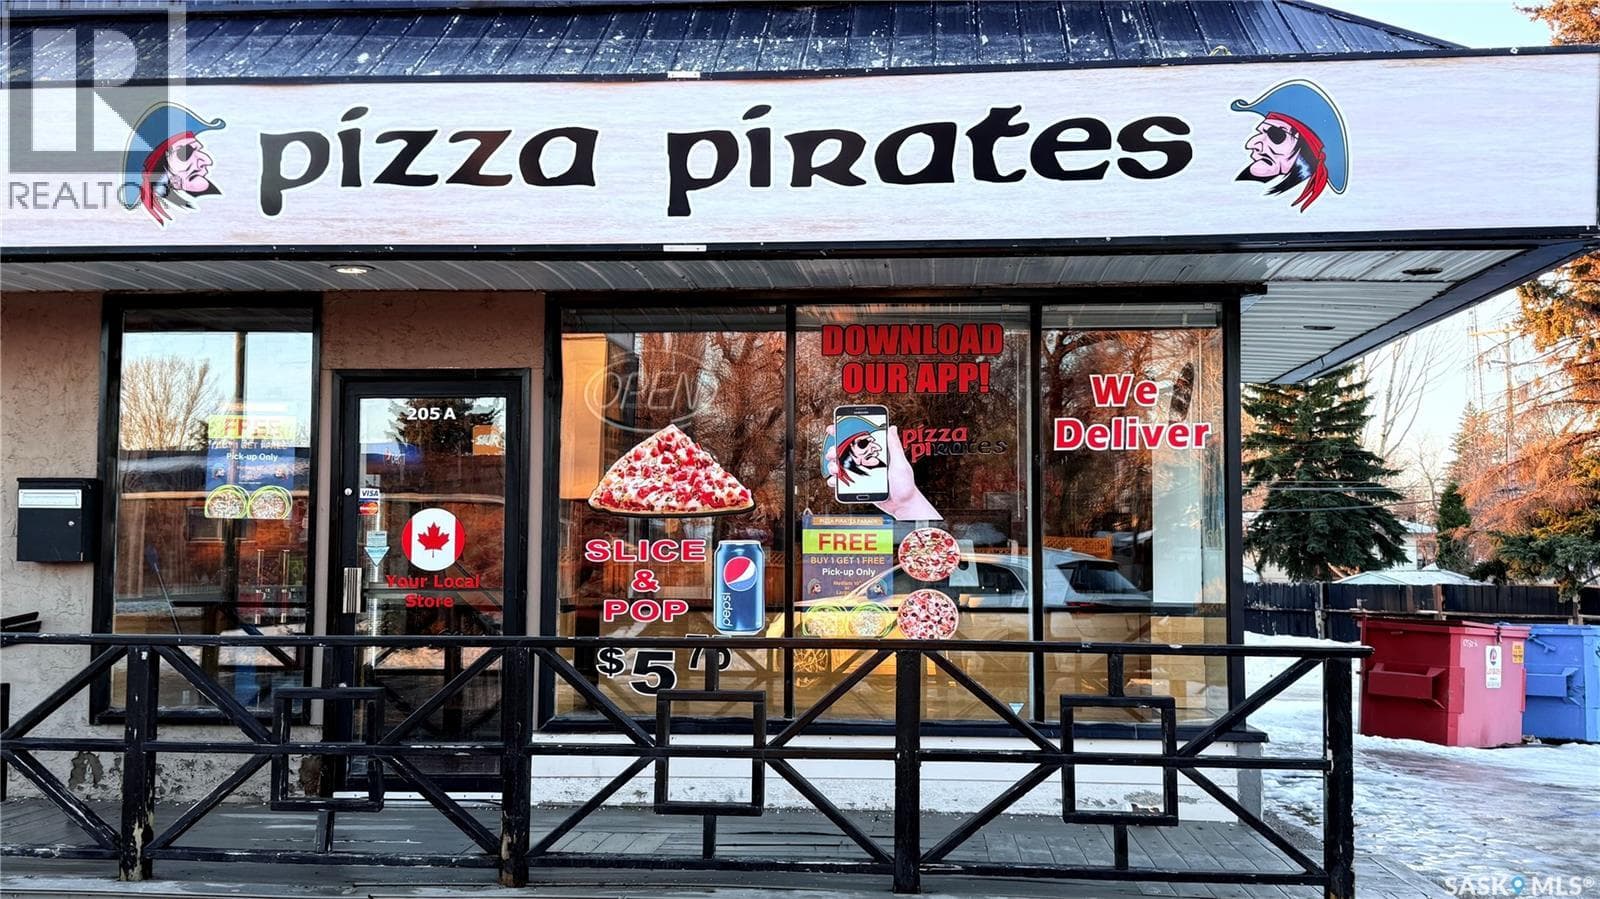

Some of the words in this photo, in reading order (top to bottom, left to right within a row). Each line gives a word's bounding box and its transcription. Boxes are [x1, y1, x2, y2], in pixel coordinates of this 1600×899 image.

[259, 105, 600, 218] pizza
[666, 104, 1193, 217] pirates
[821, 323, 1004, 356] DOWNLOAD
[842, 361, 909, 394] OUR
[915, 361, 991, 394] APP!
[592, 371, 702, 411] OPEN
[1089, 373, 1159, 408] We
[406, 407, 441, 420] 205
[443, 407, 456, 420] A
[902, 424, 968, 448] pizza
[1053, 416, 1212, 451] Deliver
[226, 452, 257, 461] Pick-up
[259, 452, 278, 461] Only
[911, 438, 1009, 464] pirates
[361, 489, 379, 497] VISA
[584, 539, 706, 562] SLICE
[818, 533, 878, 551] FREE
[810, 556, 829, 565] BUY
[837, 556, 854, 565] GET
[862, 556, 885, 565] FREE
[822, 567, 854, 577] Pick-up
[856, 567, 876, 577] Only
[385, 574, 428, 588] Your
[434, 574, 481, 588] Local
[631, 569, 660, 592] &
[404, 593, 455, 608] Store
[603, 599, 689, 622] POP
[722, 592, 733, 626] pepsi
